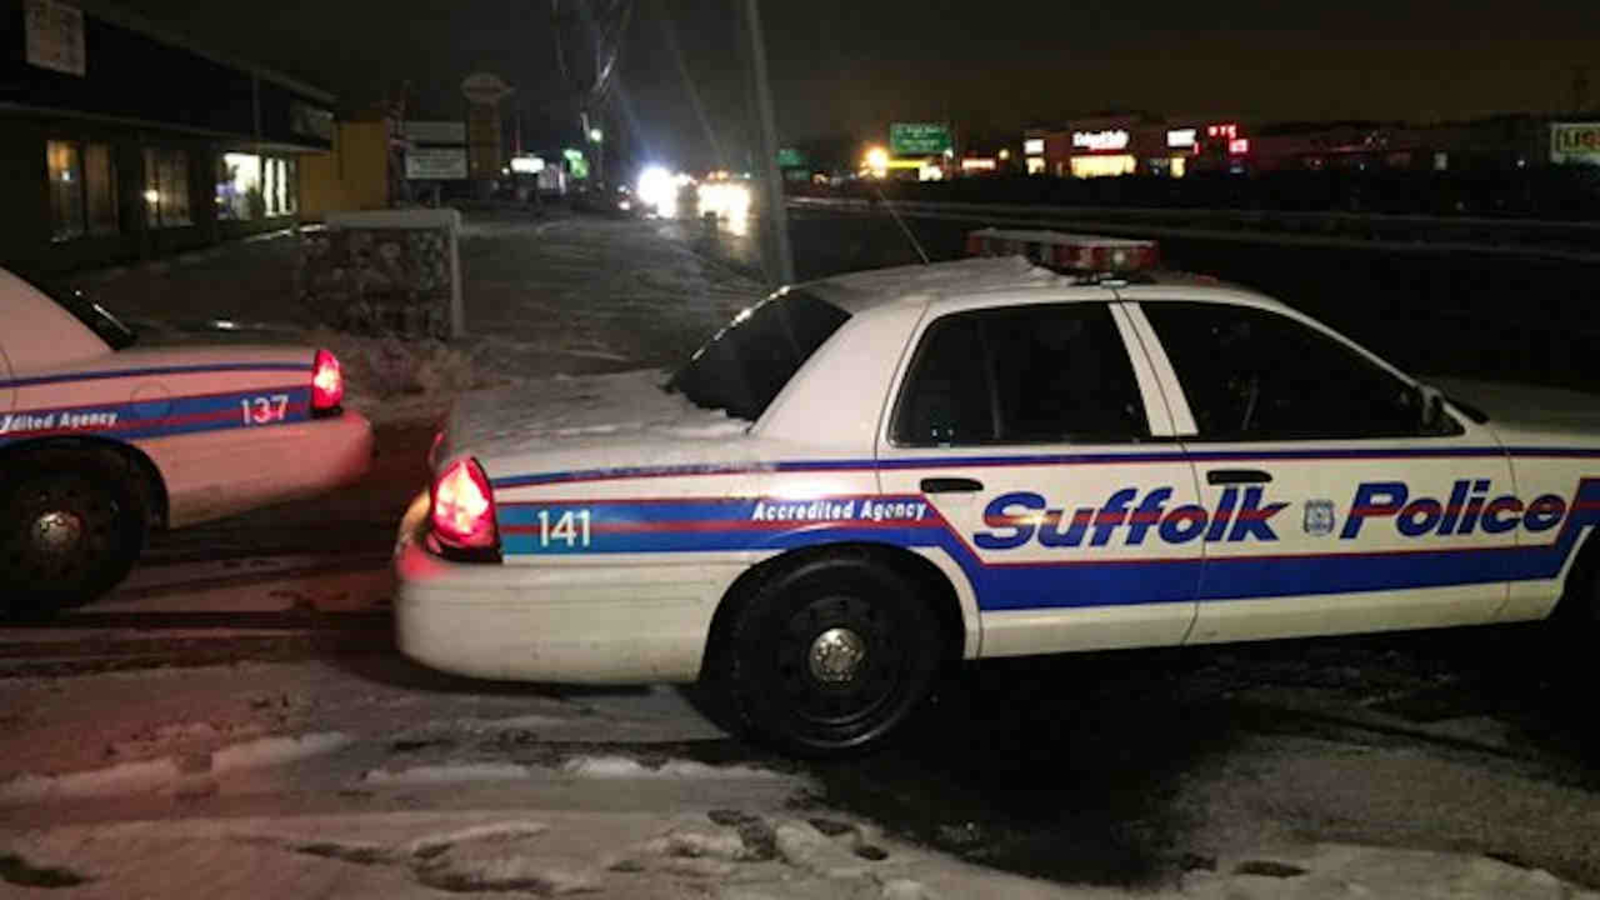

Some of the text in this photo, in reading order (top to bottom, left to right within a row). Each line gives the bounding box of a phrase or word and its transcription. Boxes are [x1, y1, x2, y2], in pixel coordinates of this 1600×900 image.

[59, 410, 119, 429] Agency
[240, 395, 289, 425] 137
[752, 498, 927, 521] Accredited Agency
[973, 479, 1568, 550] Suffolk Police
[536, 509, 591, 547] 141
